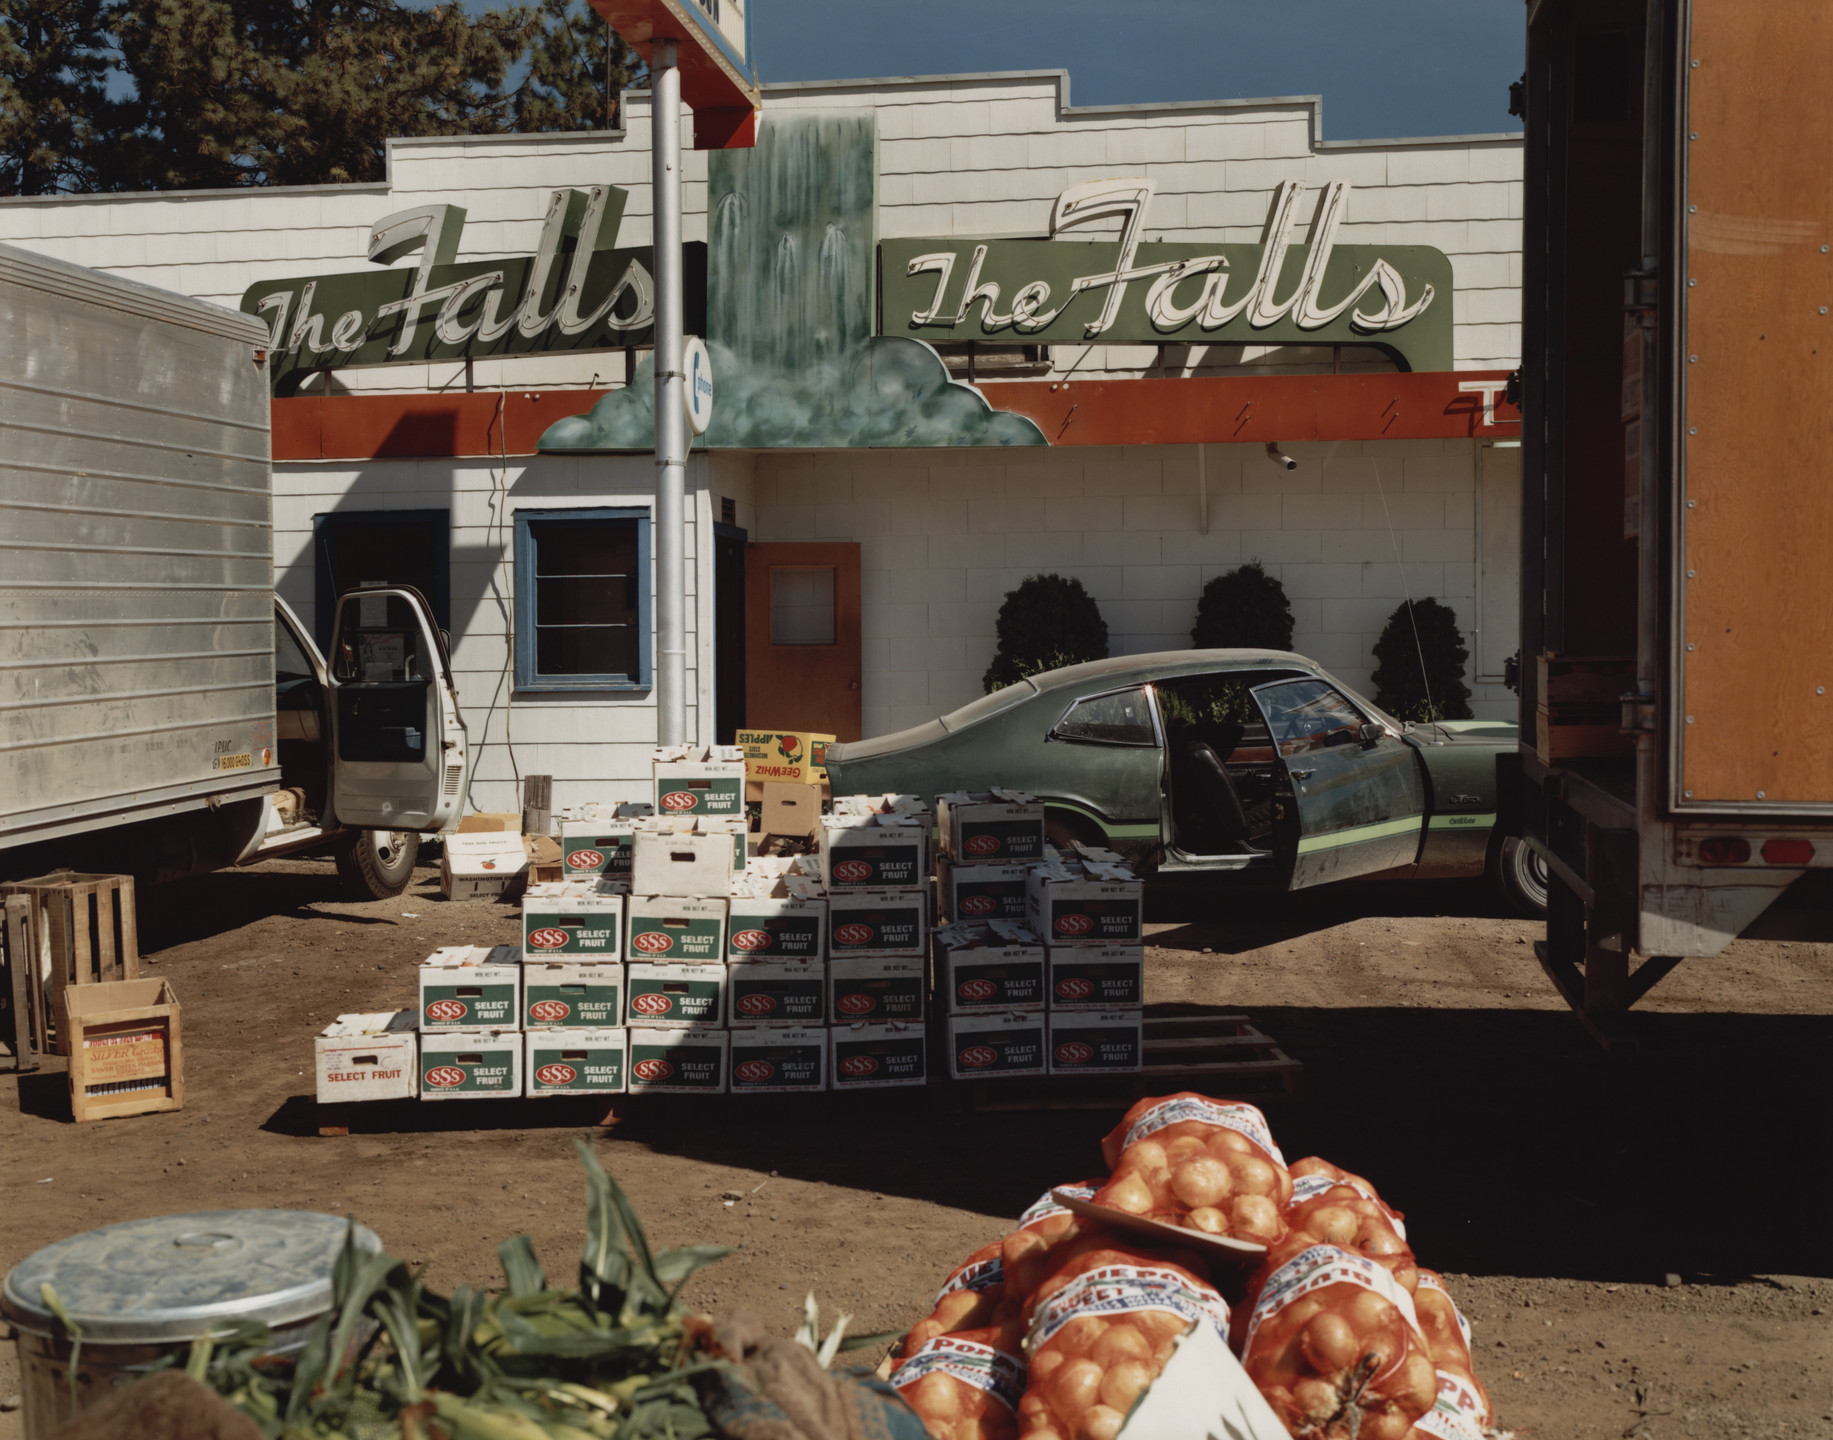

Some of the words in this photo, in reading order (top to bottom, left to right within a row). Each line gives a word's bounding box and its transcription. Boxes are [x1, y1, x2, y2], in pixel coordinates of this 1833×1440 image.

[907, 244, 1072, 328] The
[1051, 178, 1436, 336] Falls
[256, 281, 362, 354] The
[368, 185, 655, 355] Falls
[698, 373, 712, 397] phone
[755, 766, 801, 778] GEEWHIZ
[666, 792, 693, 807] SSS
[969, 836, 996, 851] SSS
[572, 850, 599, 865] SSS
[611, 850, 631, 859] SELE
[614, 859, 631, 867] FRU
[839, 862, 867, 877] SSS
[879, 862, 912, 870] SELECT
[965, 896, 992, 911] SSS
[1060, 915, 1088, 930] SSS
[1100, 916, 1133, 924] SELECT
[534, 928, 563, 944] SSS
[576, 930, 610, 938] SELECT
[840, 924, 868, 940] SSS
[880, 925, 914, 933] SELECT
[639, 933, 667, 948] SSS
[738, 931, 766, 946] SSS
[779, 933, 812, 941] SELECT
[964, 980, 992, 996] SSS
[1061, 979, 1089, 995] SSS
[475, 1001, 509, 1009] SELECT
[578, 1002, 612, 1010] SELECT
[638, 994, 667, 1010] SSS
[743, 995, 771, 1010] SSS
[784, 996, 817, 1004] SELECT
[843, 994, 871, 1009] SSS
[432, 1001, 461, 1017] SSS
[536, 1001, 565, 1017] SSS
[682, 1006, 708, 1015] FRUIT
[964, 1047, 992, 1063] SSS
[1060, 1044, 1088, 1059] SSS
[1100, 1044, 1133, 1052] SELECT
[473, 1067, 508, 1075] SELECT
[584, 1066, 618, 1074] SELECT
[640, 1060, 668, 1076] SSS
[682, 1063, 715, 1071] SELECT
[741, 1062, 769, 1077] SSS
[782, 1062, 815, 1070] SELECT
[845, 1056, 873, 1072] SSS
[328, 1072, 366, 1082] SELECT
[372, 1070, 402, 1079] FRUIT
[431, 1067, 460, 1083] SSS
[542, 1064, 571, 1080] SSS
[586, 1075, 613, 1083] FRUIT
